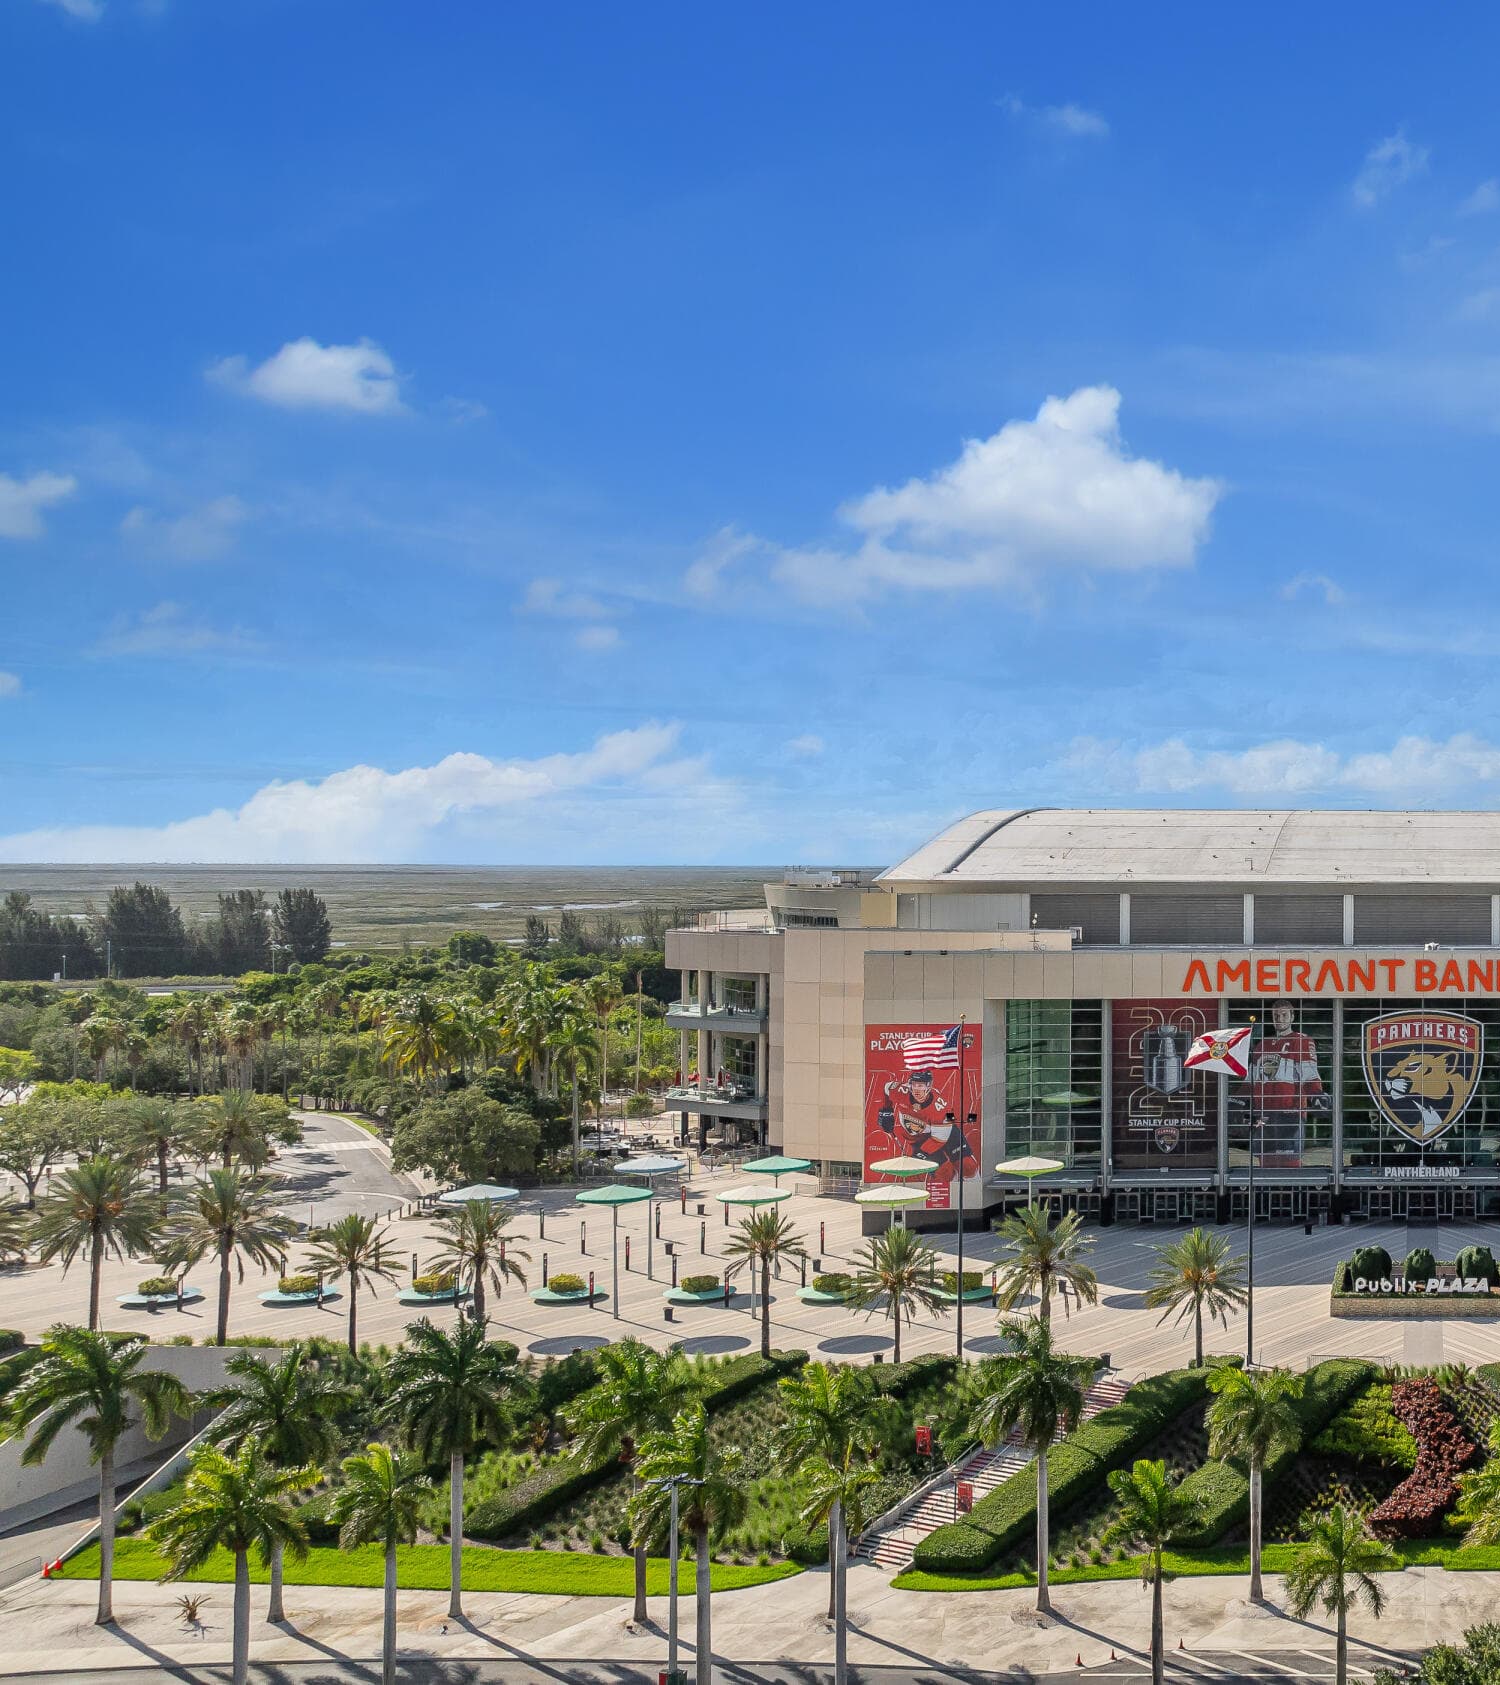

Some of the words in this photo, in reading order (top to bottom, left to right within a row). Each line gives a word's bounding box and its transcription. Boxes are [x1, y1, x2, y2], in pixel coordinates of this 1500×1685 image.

[1182, 959, 1406, 992] AMERANT
[1378, 1022, 1468, 1044] PANTHERS
[870, 1040, 906, 1051] PLAY
[1128, 1118, 1163, 1127] STANLEY
[1163, 1118, 1180, 1127] CUP
[1181, 1118, 1205, 1127] FINAL
[1384, 1166, 1460, 1178] PANTHERLAND
[1424, 1277, 1489, 1293] PLAZA
